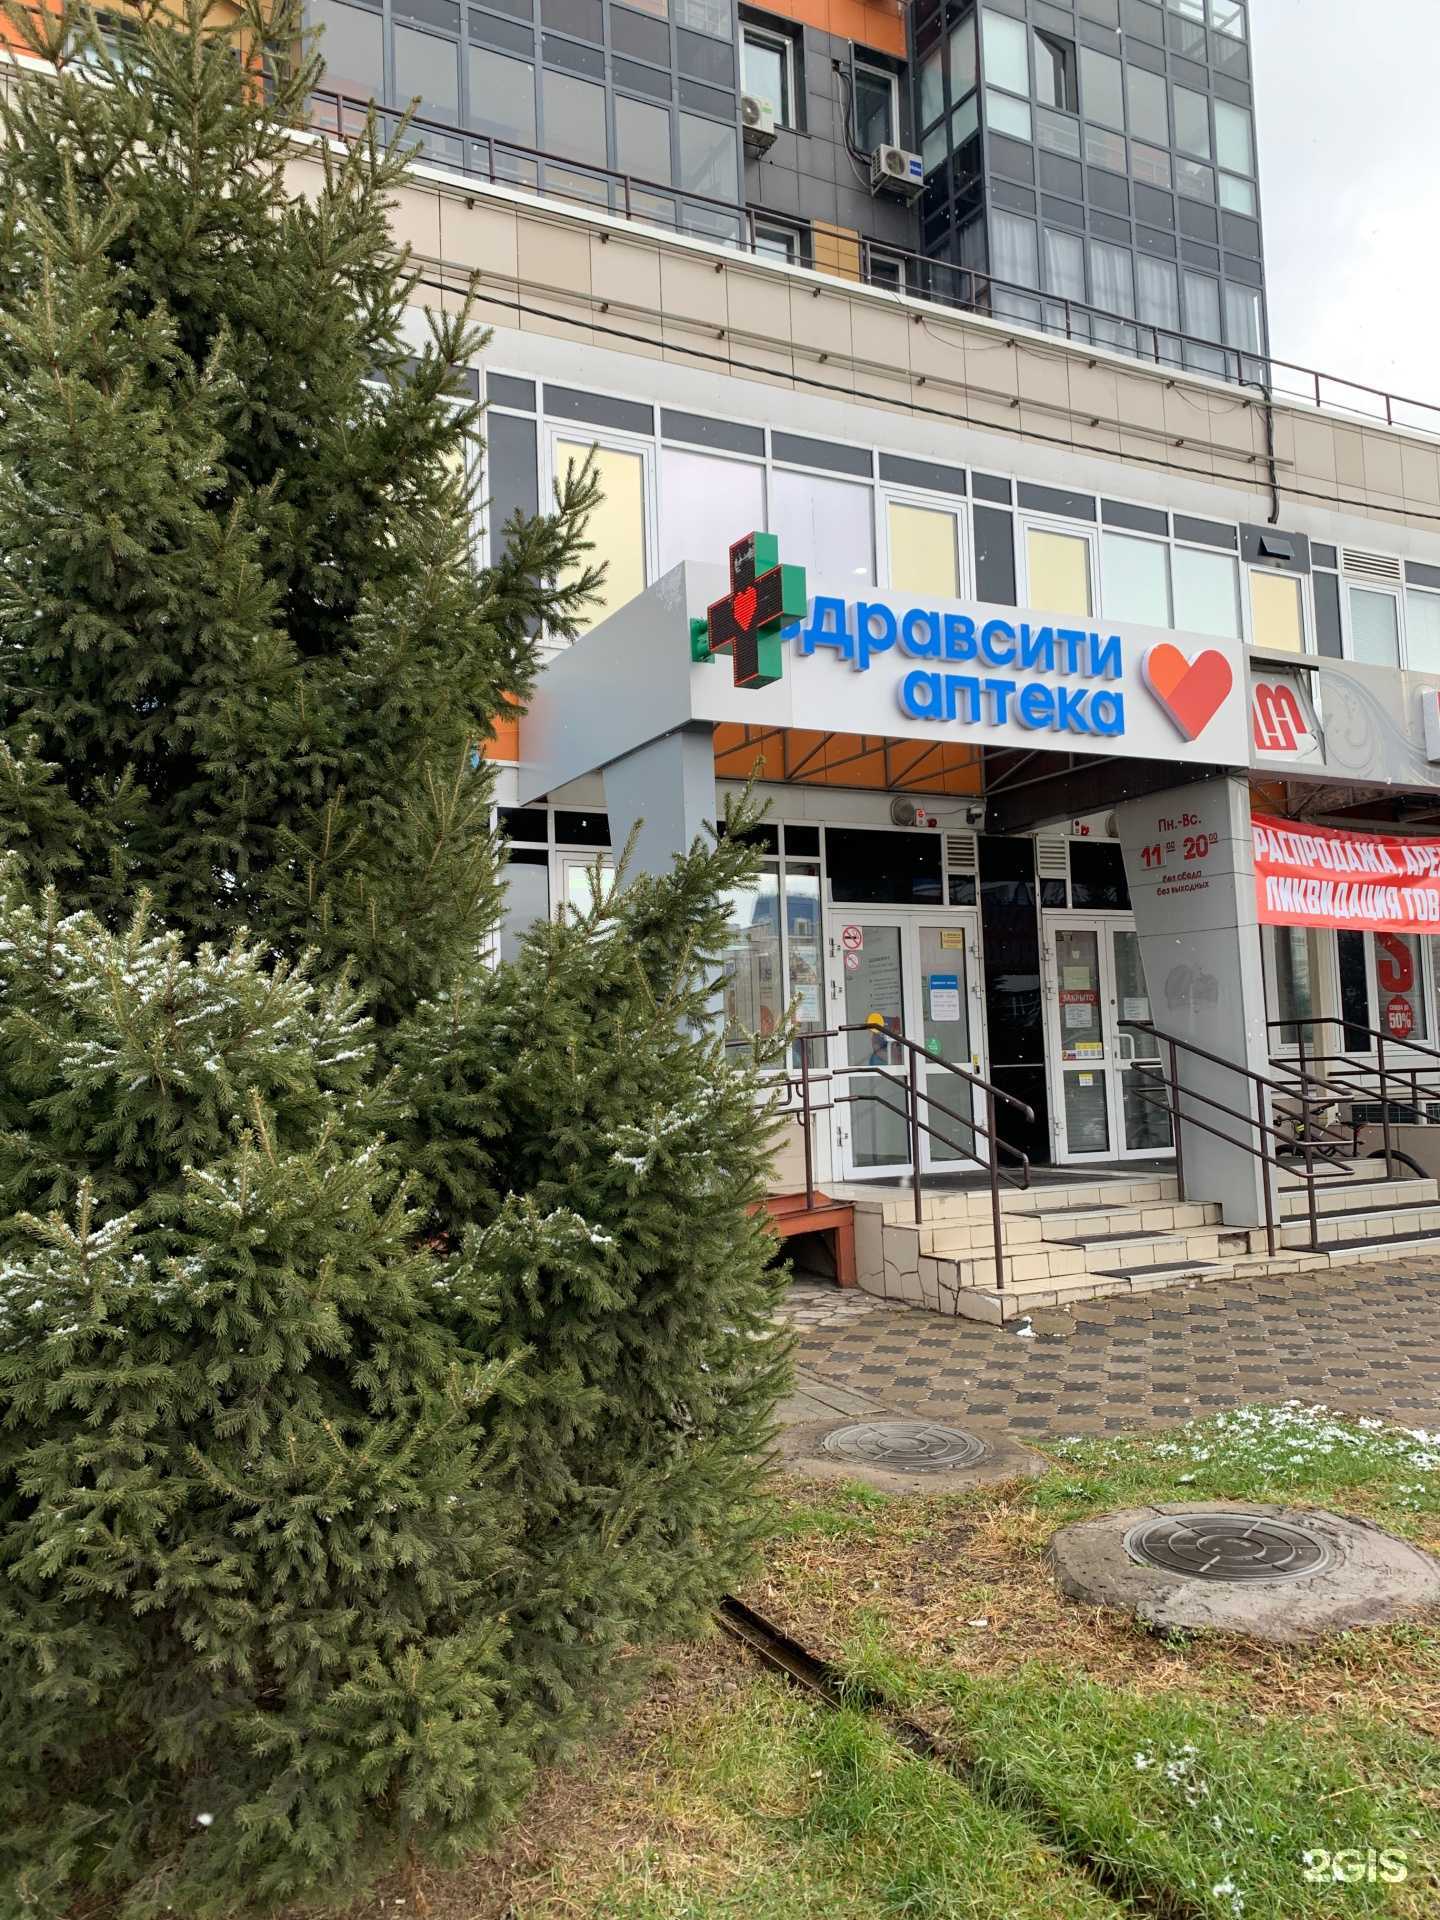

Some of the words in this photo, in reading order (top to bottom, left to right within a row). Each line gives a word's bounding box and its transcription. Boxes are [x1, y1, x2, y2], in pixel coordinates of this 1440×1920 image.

[781, 596, 1122, 679] дравсити
[902, 669, 1125, 736] аптека
[1158, 813, 1202, 832] Пн.-Вс.
[1183, 834, 1209, 860] 20
[1253, 826, 1403, 878] РАСПРОДАЖА,
[1401, 845, 1440, 878] АРЕ
[1157, 886, 1170, 896] без
[1171, 881, 1209, 894] выходных
[1176, 870, 1202, 881] обеда
[1265, 875, 1403, 920] ЛИКВИДАЦИЯ
[1388, 1012, 1412, 1029] 50%
